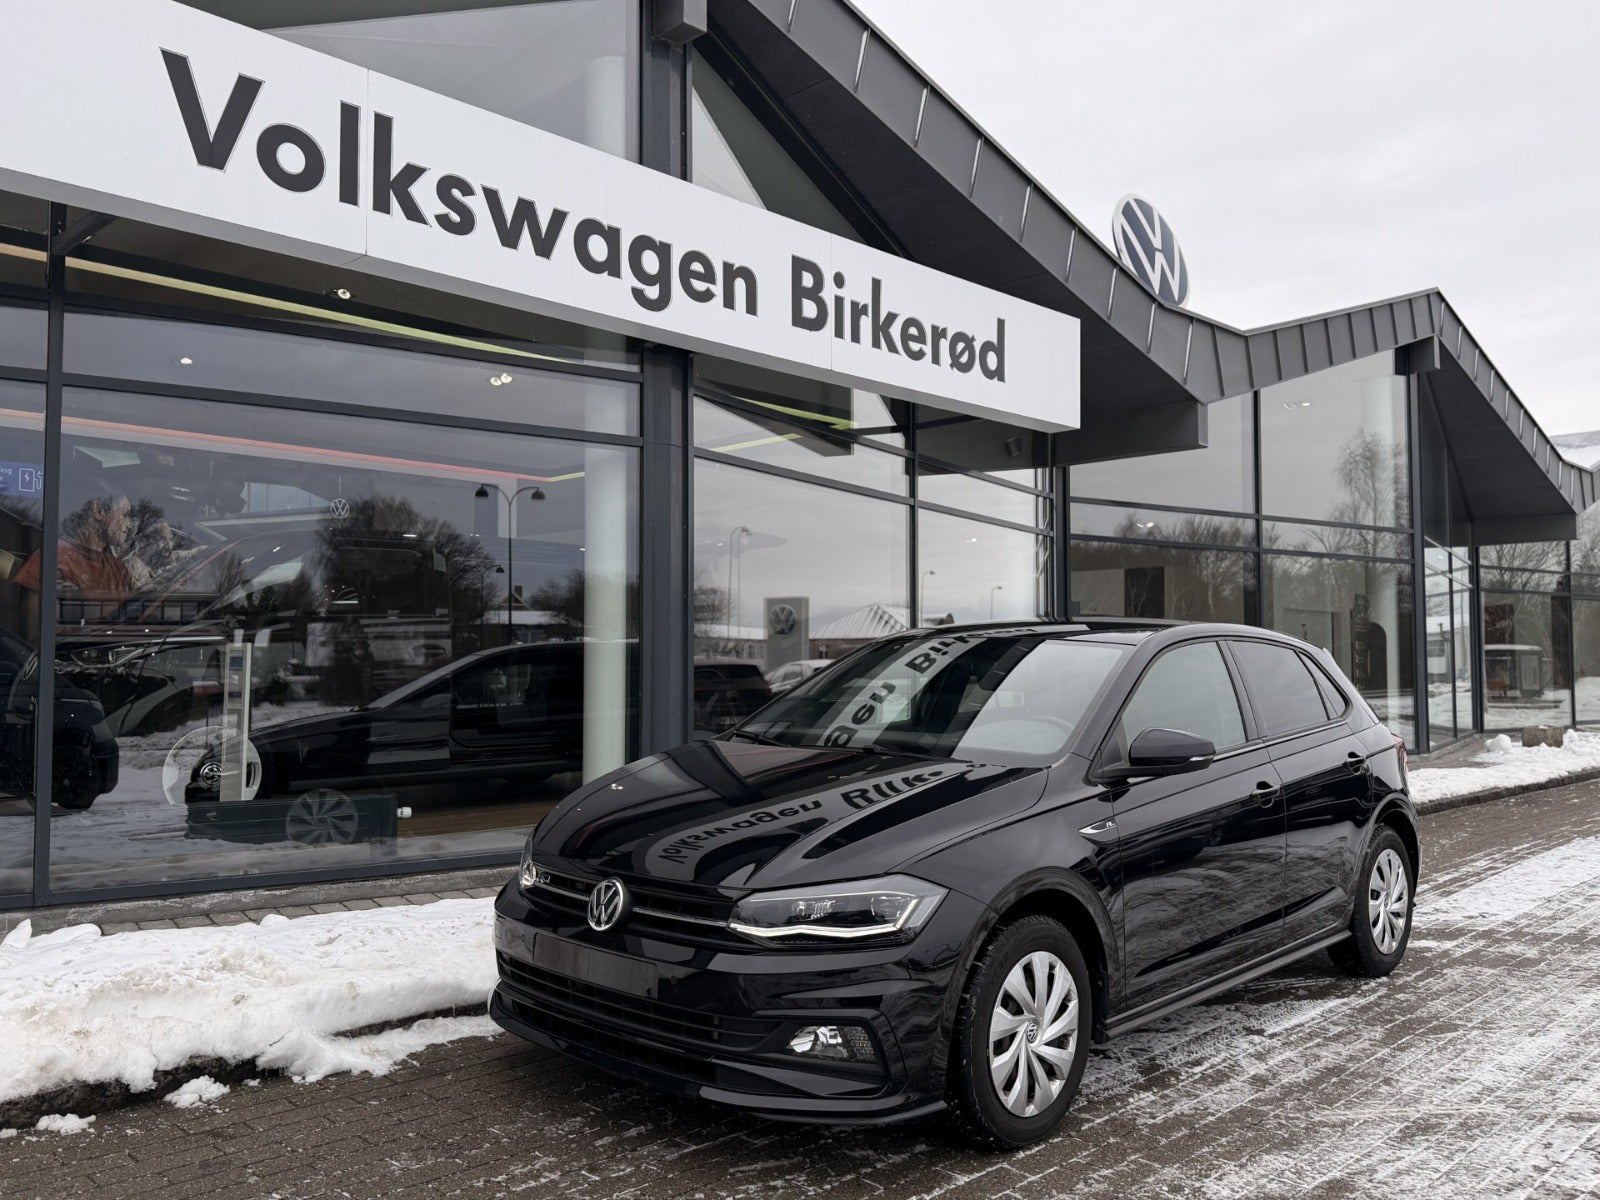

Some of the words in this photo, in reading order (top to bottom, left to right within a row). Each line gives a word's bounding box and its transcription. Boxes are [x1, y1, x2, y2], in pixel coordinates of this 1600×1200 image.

[159, 46, 758, 312] Volkswagen
[790, 253, 1006, 383] Birkerød
[1112, 193, 1190, 307] VW
[330, 498, 350, 519] VW
[587, 878, 623, 931] VW
